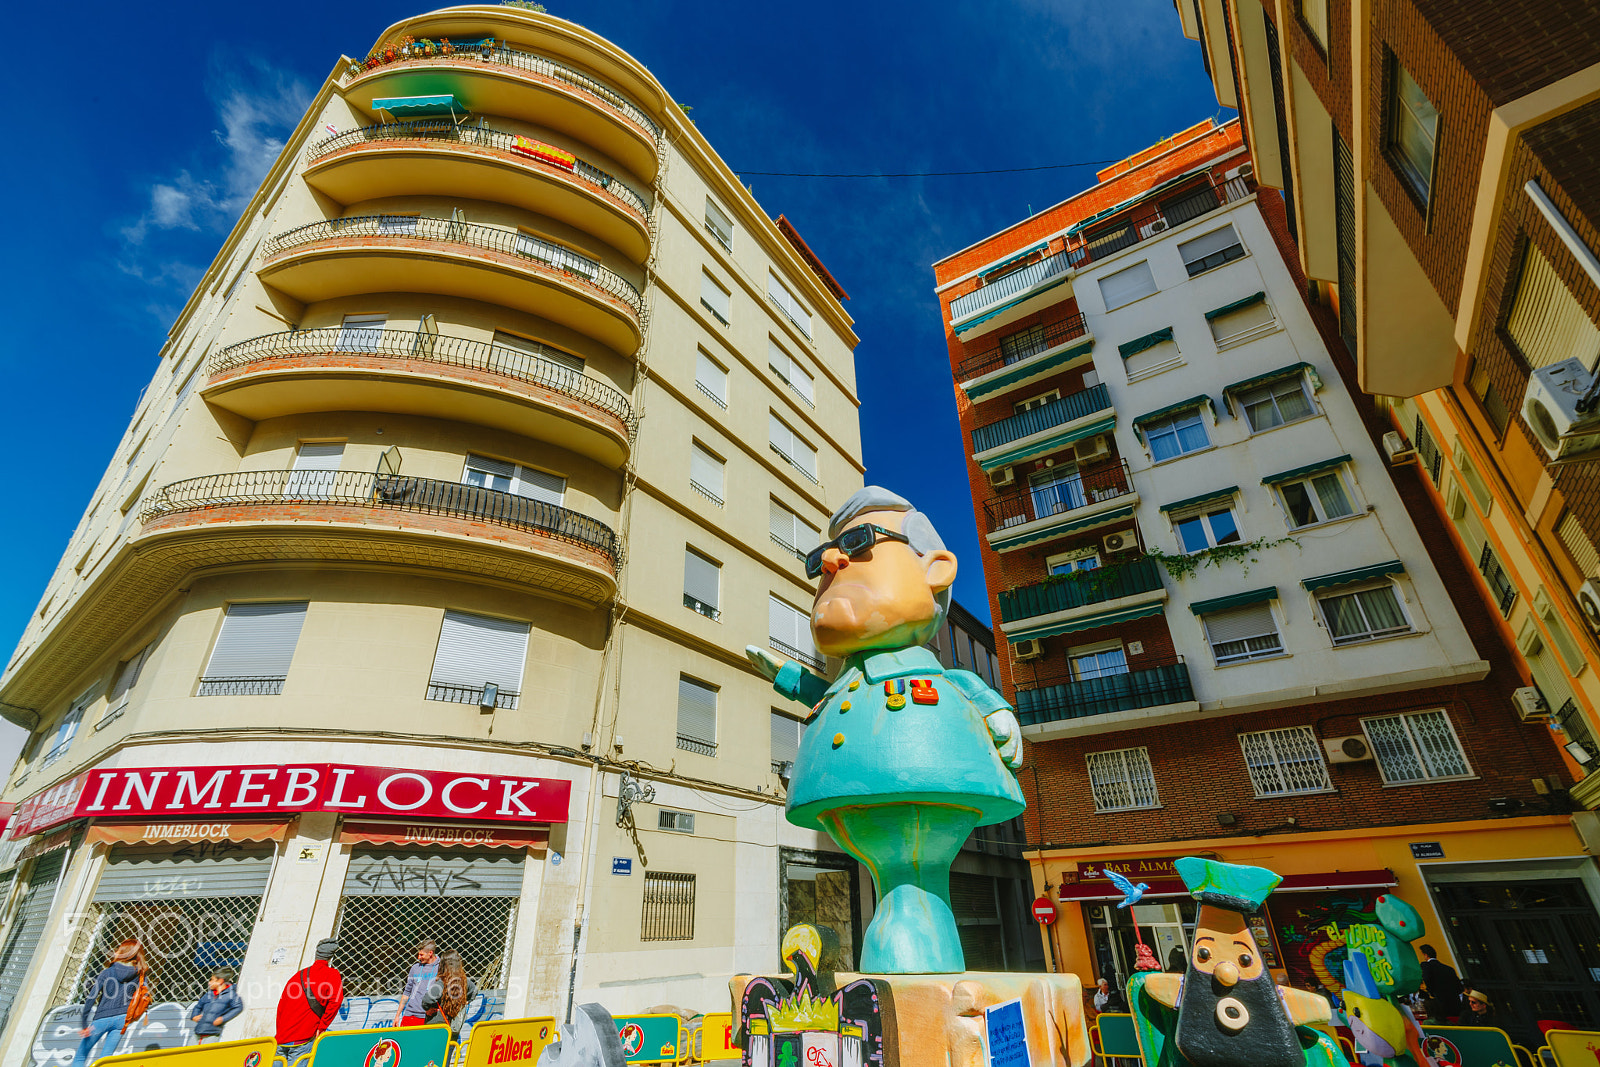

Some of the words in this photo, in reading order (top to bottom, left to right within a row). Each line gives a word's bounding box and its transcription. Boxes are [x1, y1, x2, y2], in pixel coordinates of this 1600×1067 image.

[86, 768, 539, 816] INMEBLOCK
[142, 823, 231, 838] INMEBLOCK
[405, 827, 495, 843] INMEBLOCK
[1104, 862, 1132, 873] BAR
[1139, 860, 1177, 872] ALMA
[487, 1034, 533, 1065] Fallera
